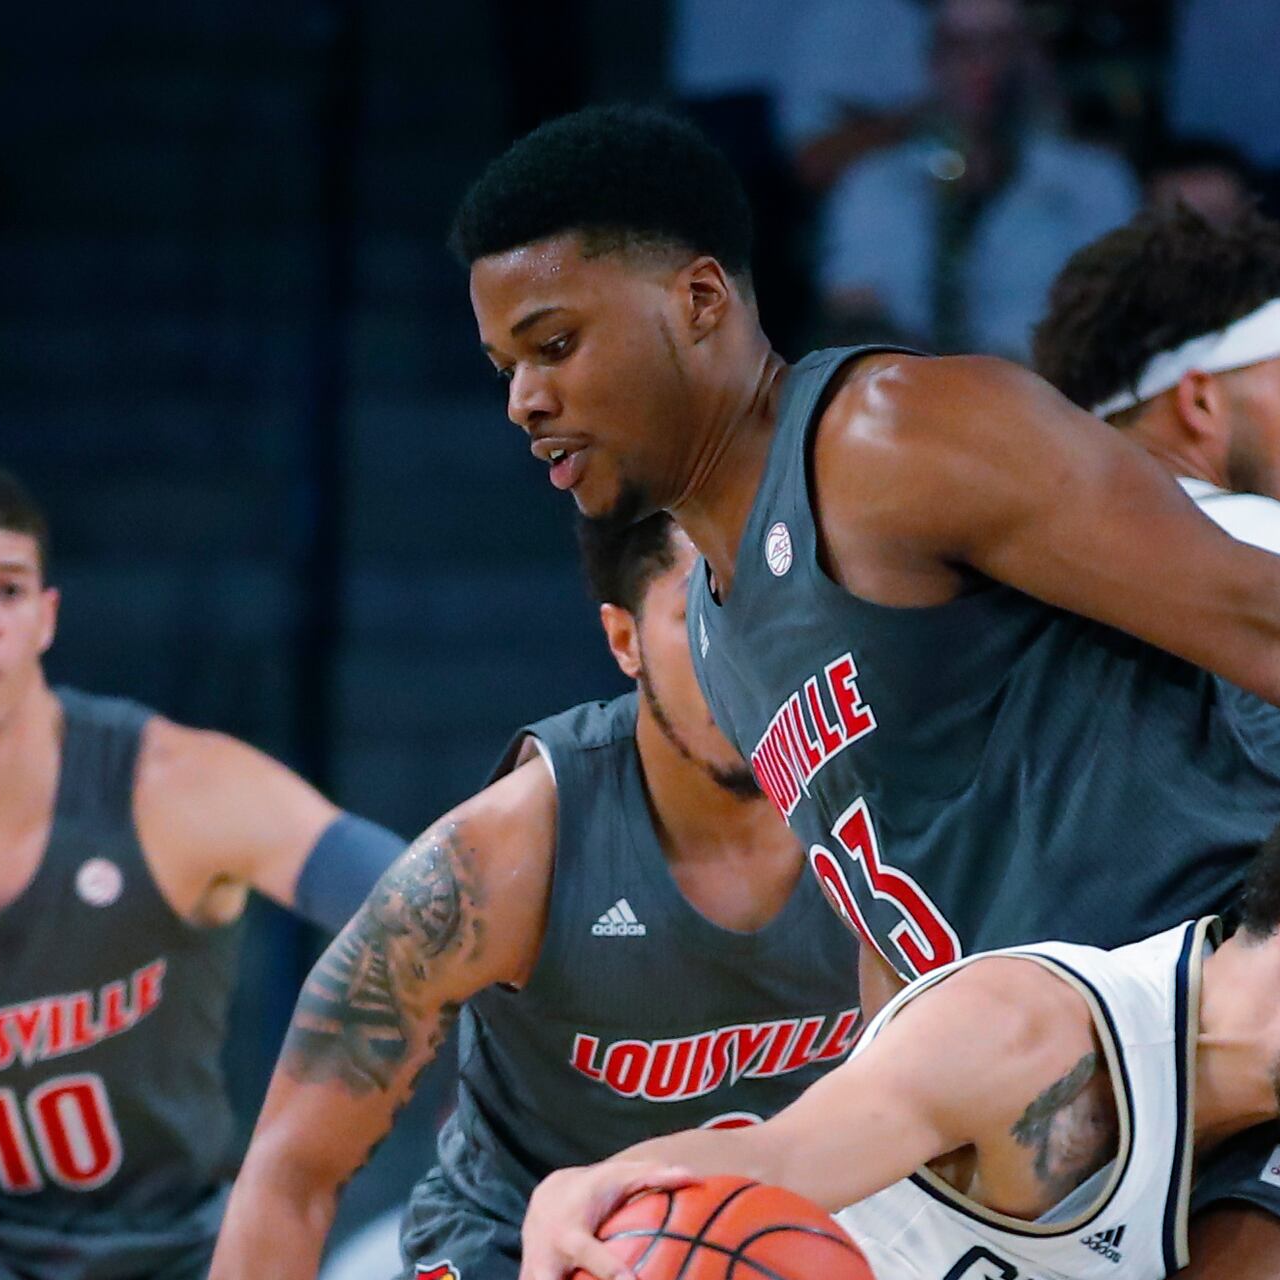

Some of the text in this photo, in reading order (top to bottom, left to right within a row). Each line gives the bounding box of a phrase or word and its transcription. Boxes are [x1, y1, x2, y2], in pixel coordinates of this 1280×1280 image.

[592, 922, 646, 937] adidas
[568, 1007, 864, 1102] LOUISVILL
[1080, 1235, 1122, 1264] adidas
